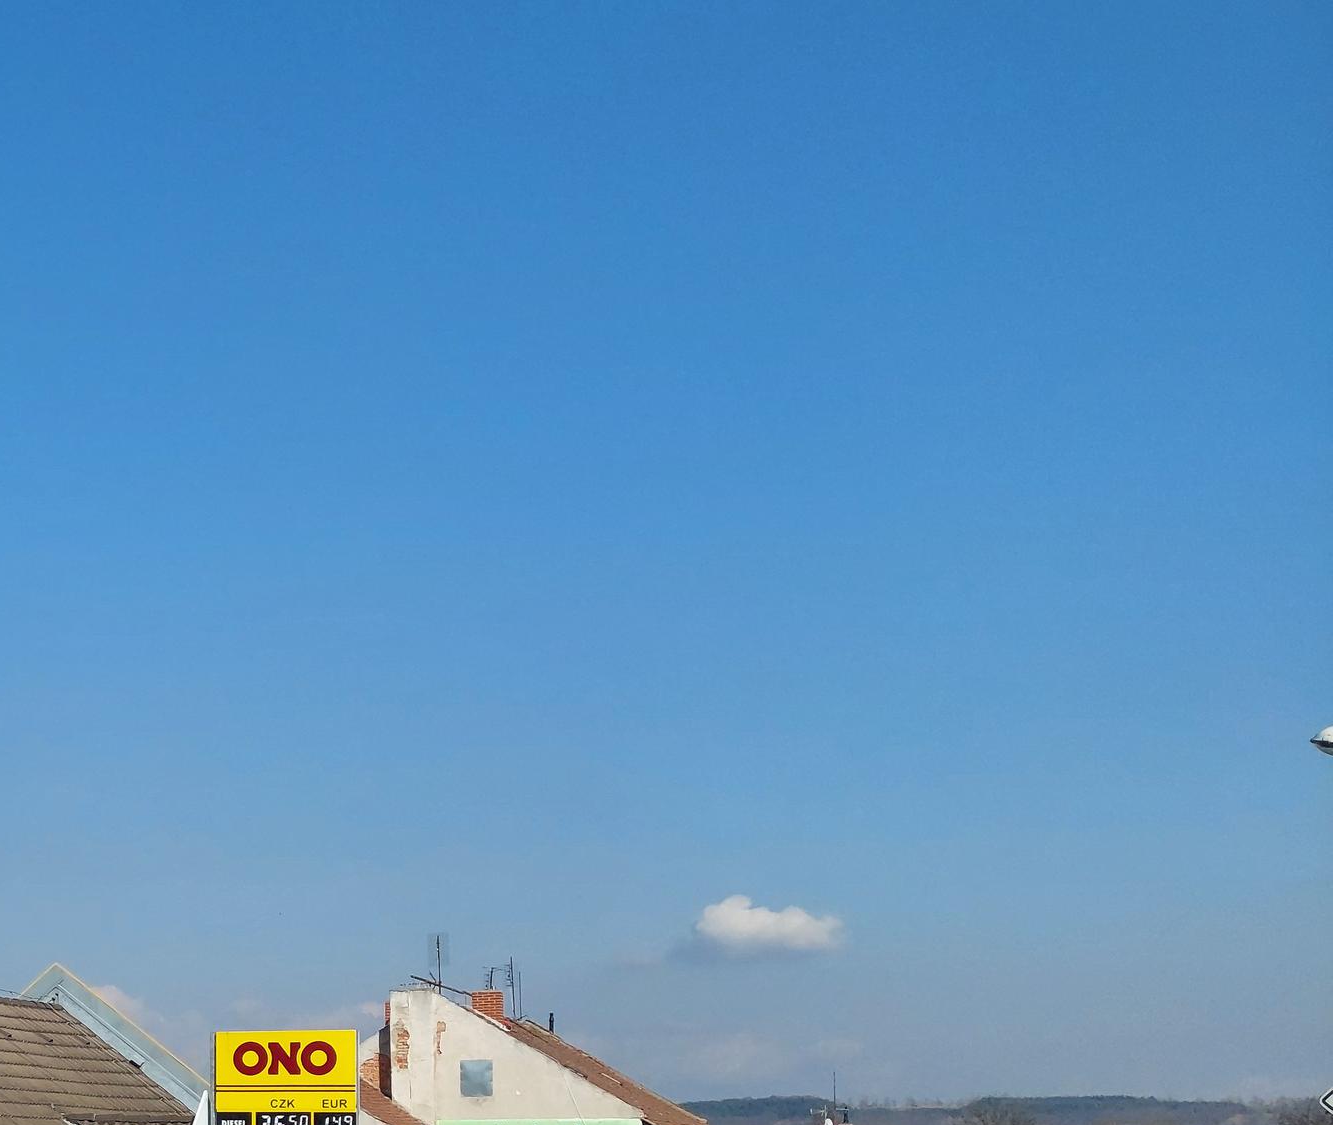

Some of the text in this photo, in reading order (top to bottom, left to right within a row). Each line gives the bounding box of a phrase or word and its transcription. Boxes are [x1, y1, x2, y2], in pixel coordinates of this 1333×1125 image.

[233, 1040, 337, 1076] ONO
[270, 1099, 348, 1109] CZK EUR
